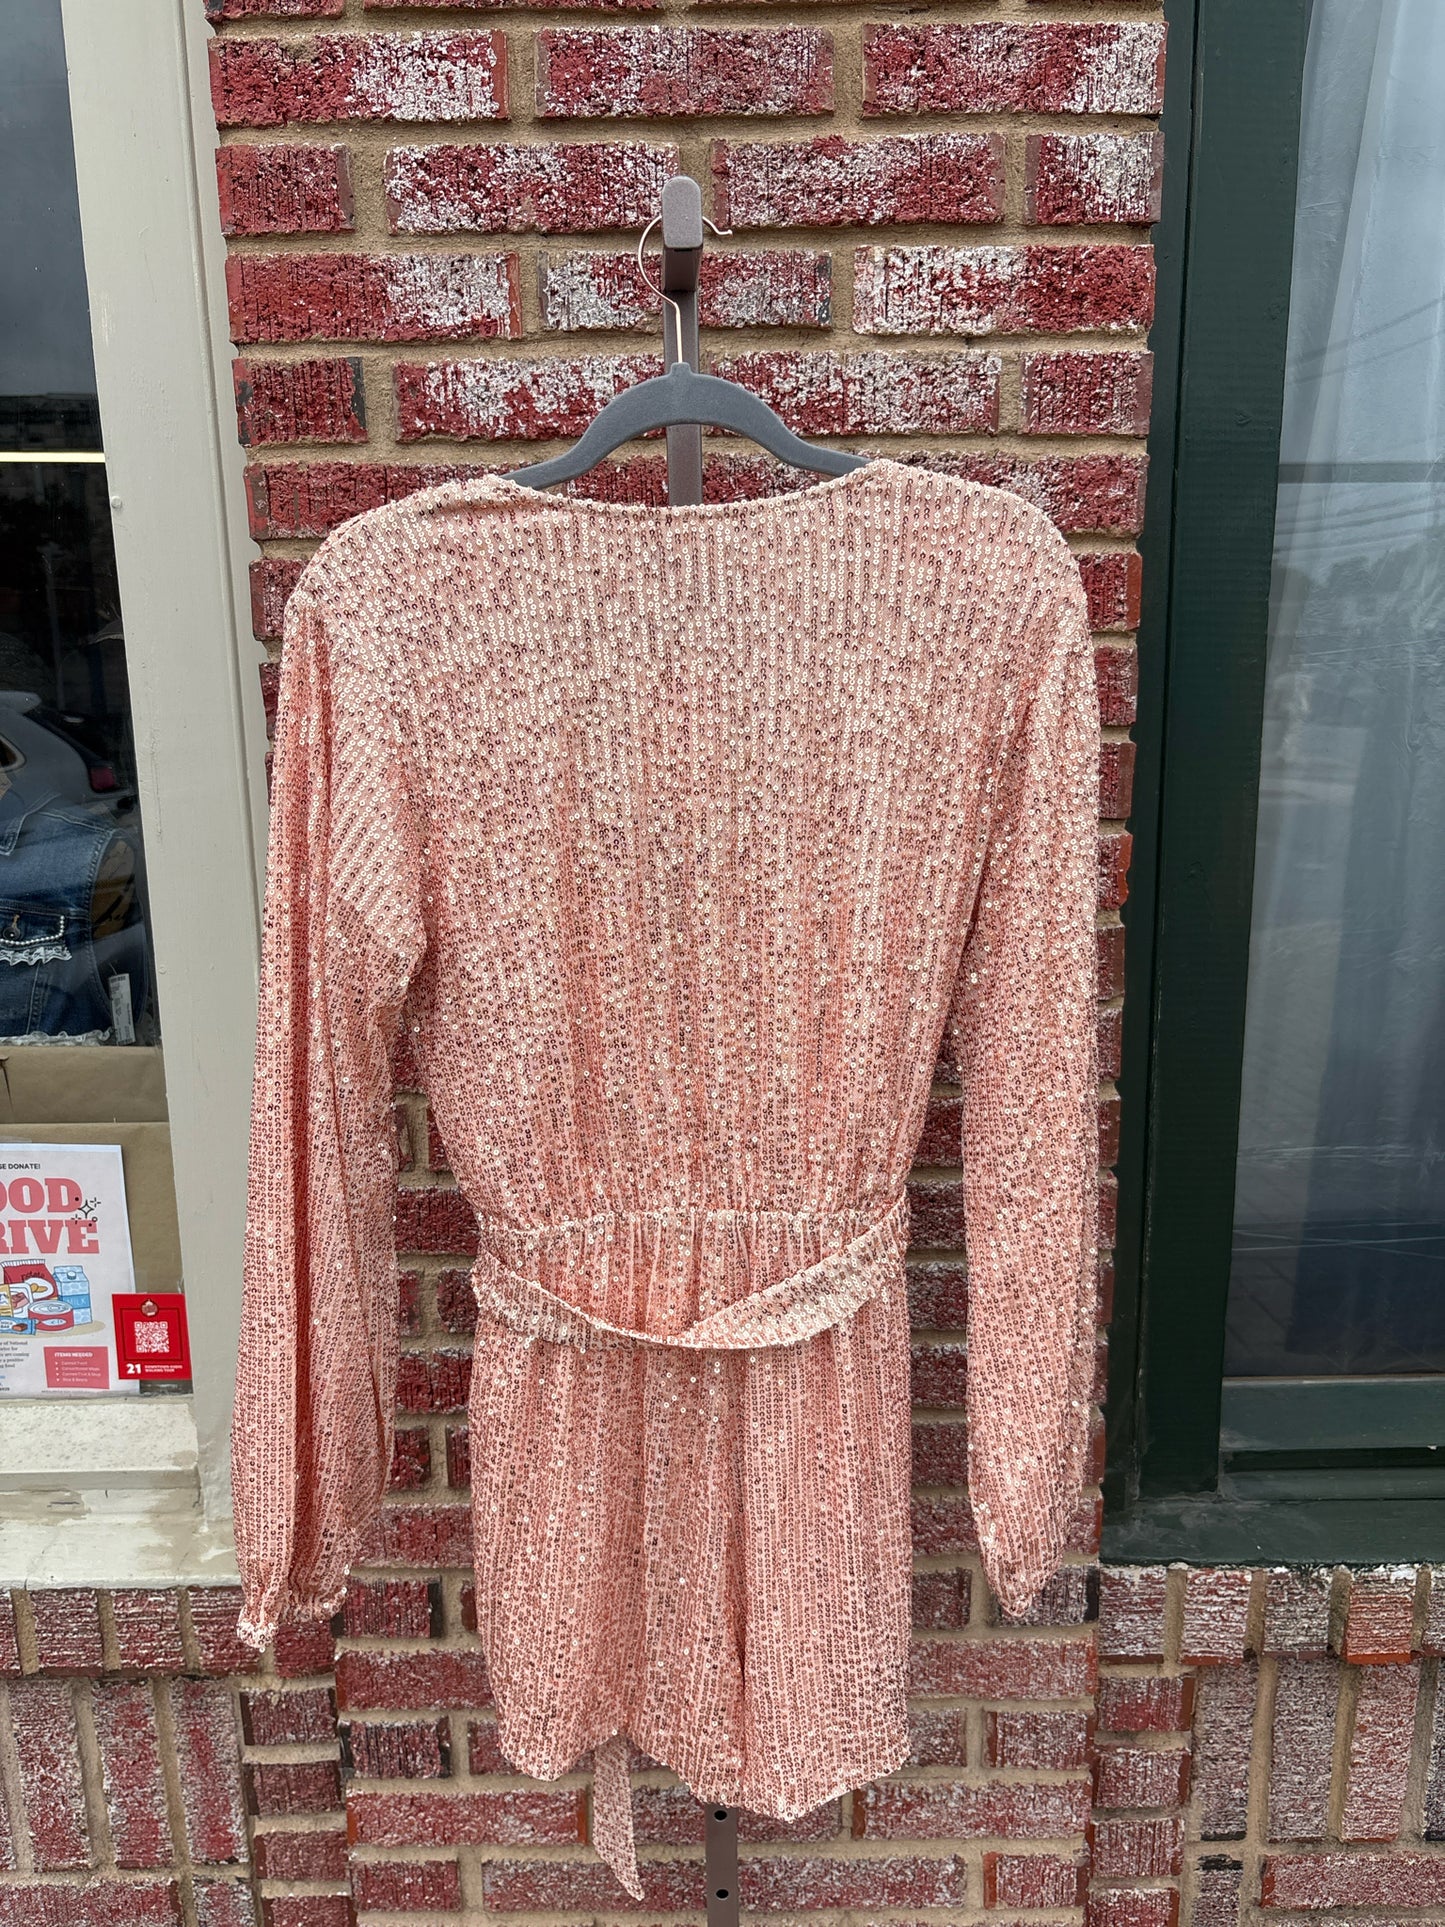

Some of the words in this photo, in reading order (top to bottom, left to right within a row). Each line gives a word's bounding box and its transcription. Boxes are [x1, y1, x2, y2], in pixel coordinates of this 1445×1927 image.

[0, 1177, 83, 1213] OD
[0, 1219, 100, 1254] IVE
[126, 1363, 142, 1375] 21
